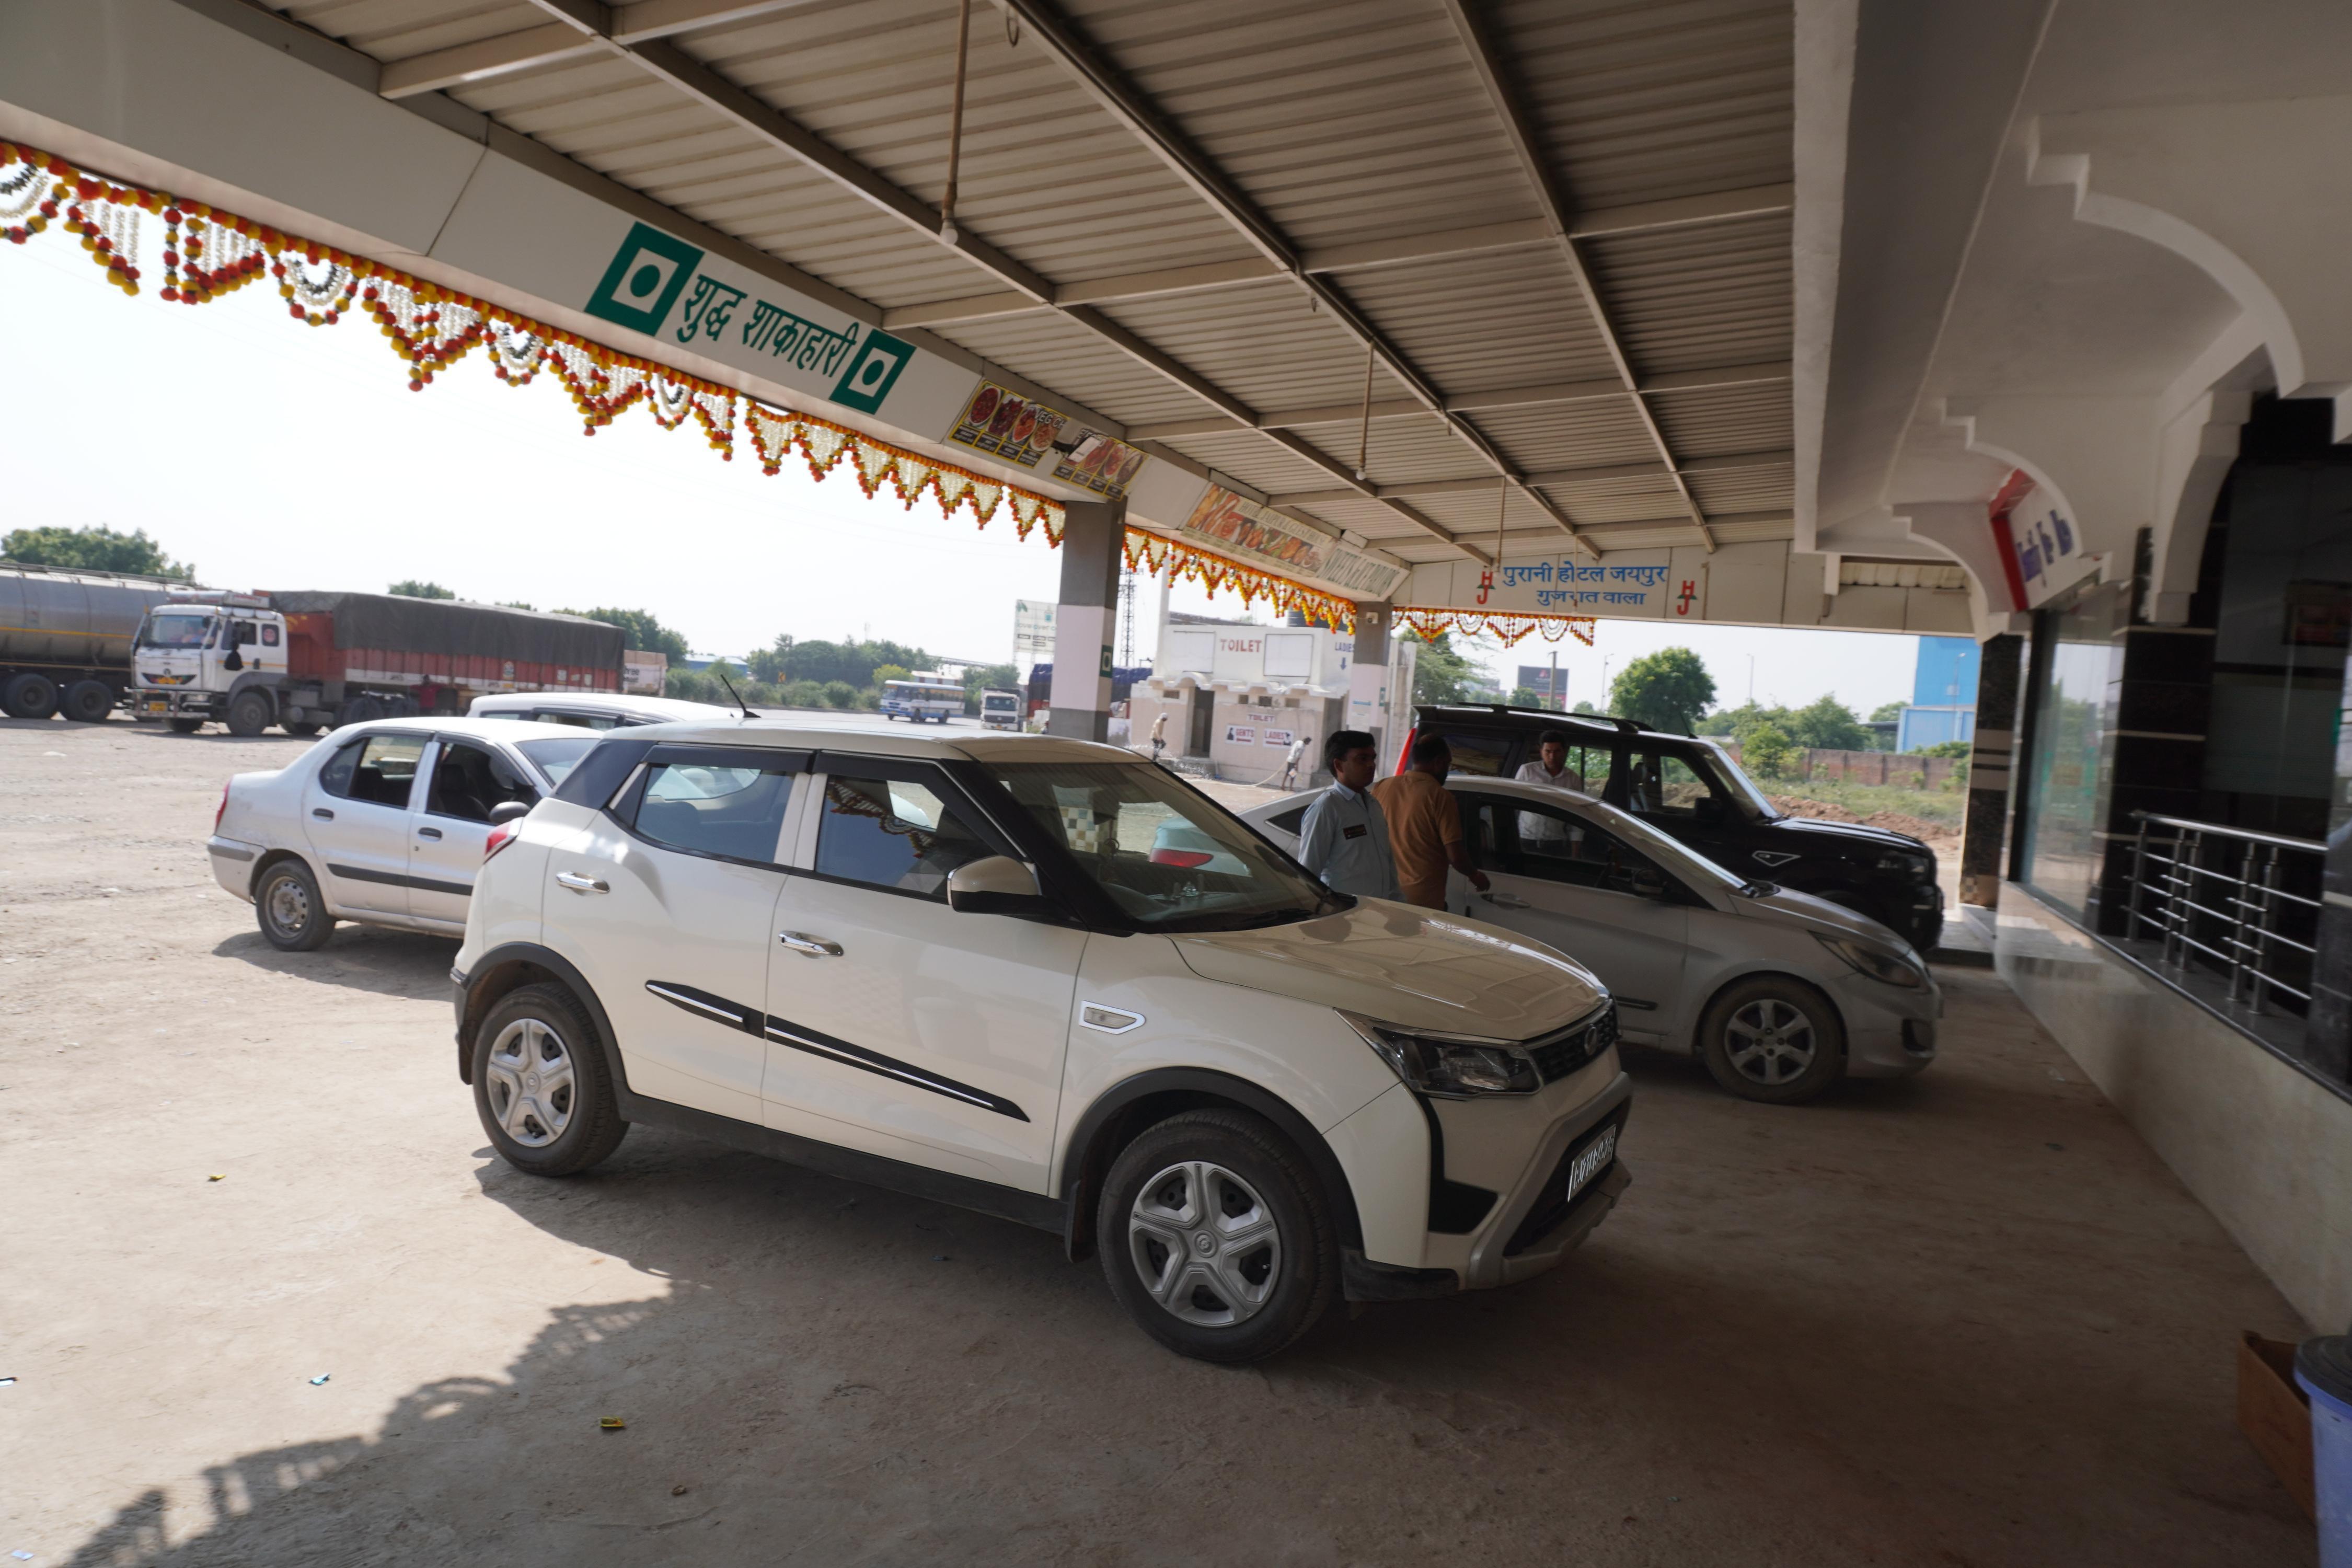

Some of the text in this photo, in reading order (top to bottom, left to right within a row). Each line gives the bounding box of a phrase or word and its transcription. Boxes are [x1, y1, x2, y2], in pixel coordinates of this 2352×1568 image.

[676, 274, 859, 378] शुद्ध शाकाहारी
[1034, 408, 1053, 424] VEG
[1502, 560, 1668, 587] पुरानी होटल जयपुर
[1603, 591, 1647, 606] वाला
[1220, 638, 1262, 653] TOILET
[1236, 728, 1255, 737] GENTS
[1264, 730, 1285, 740] LADIES
